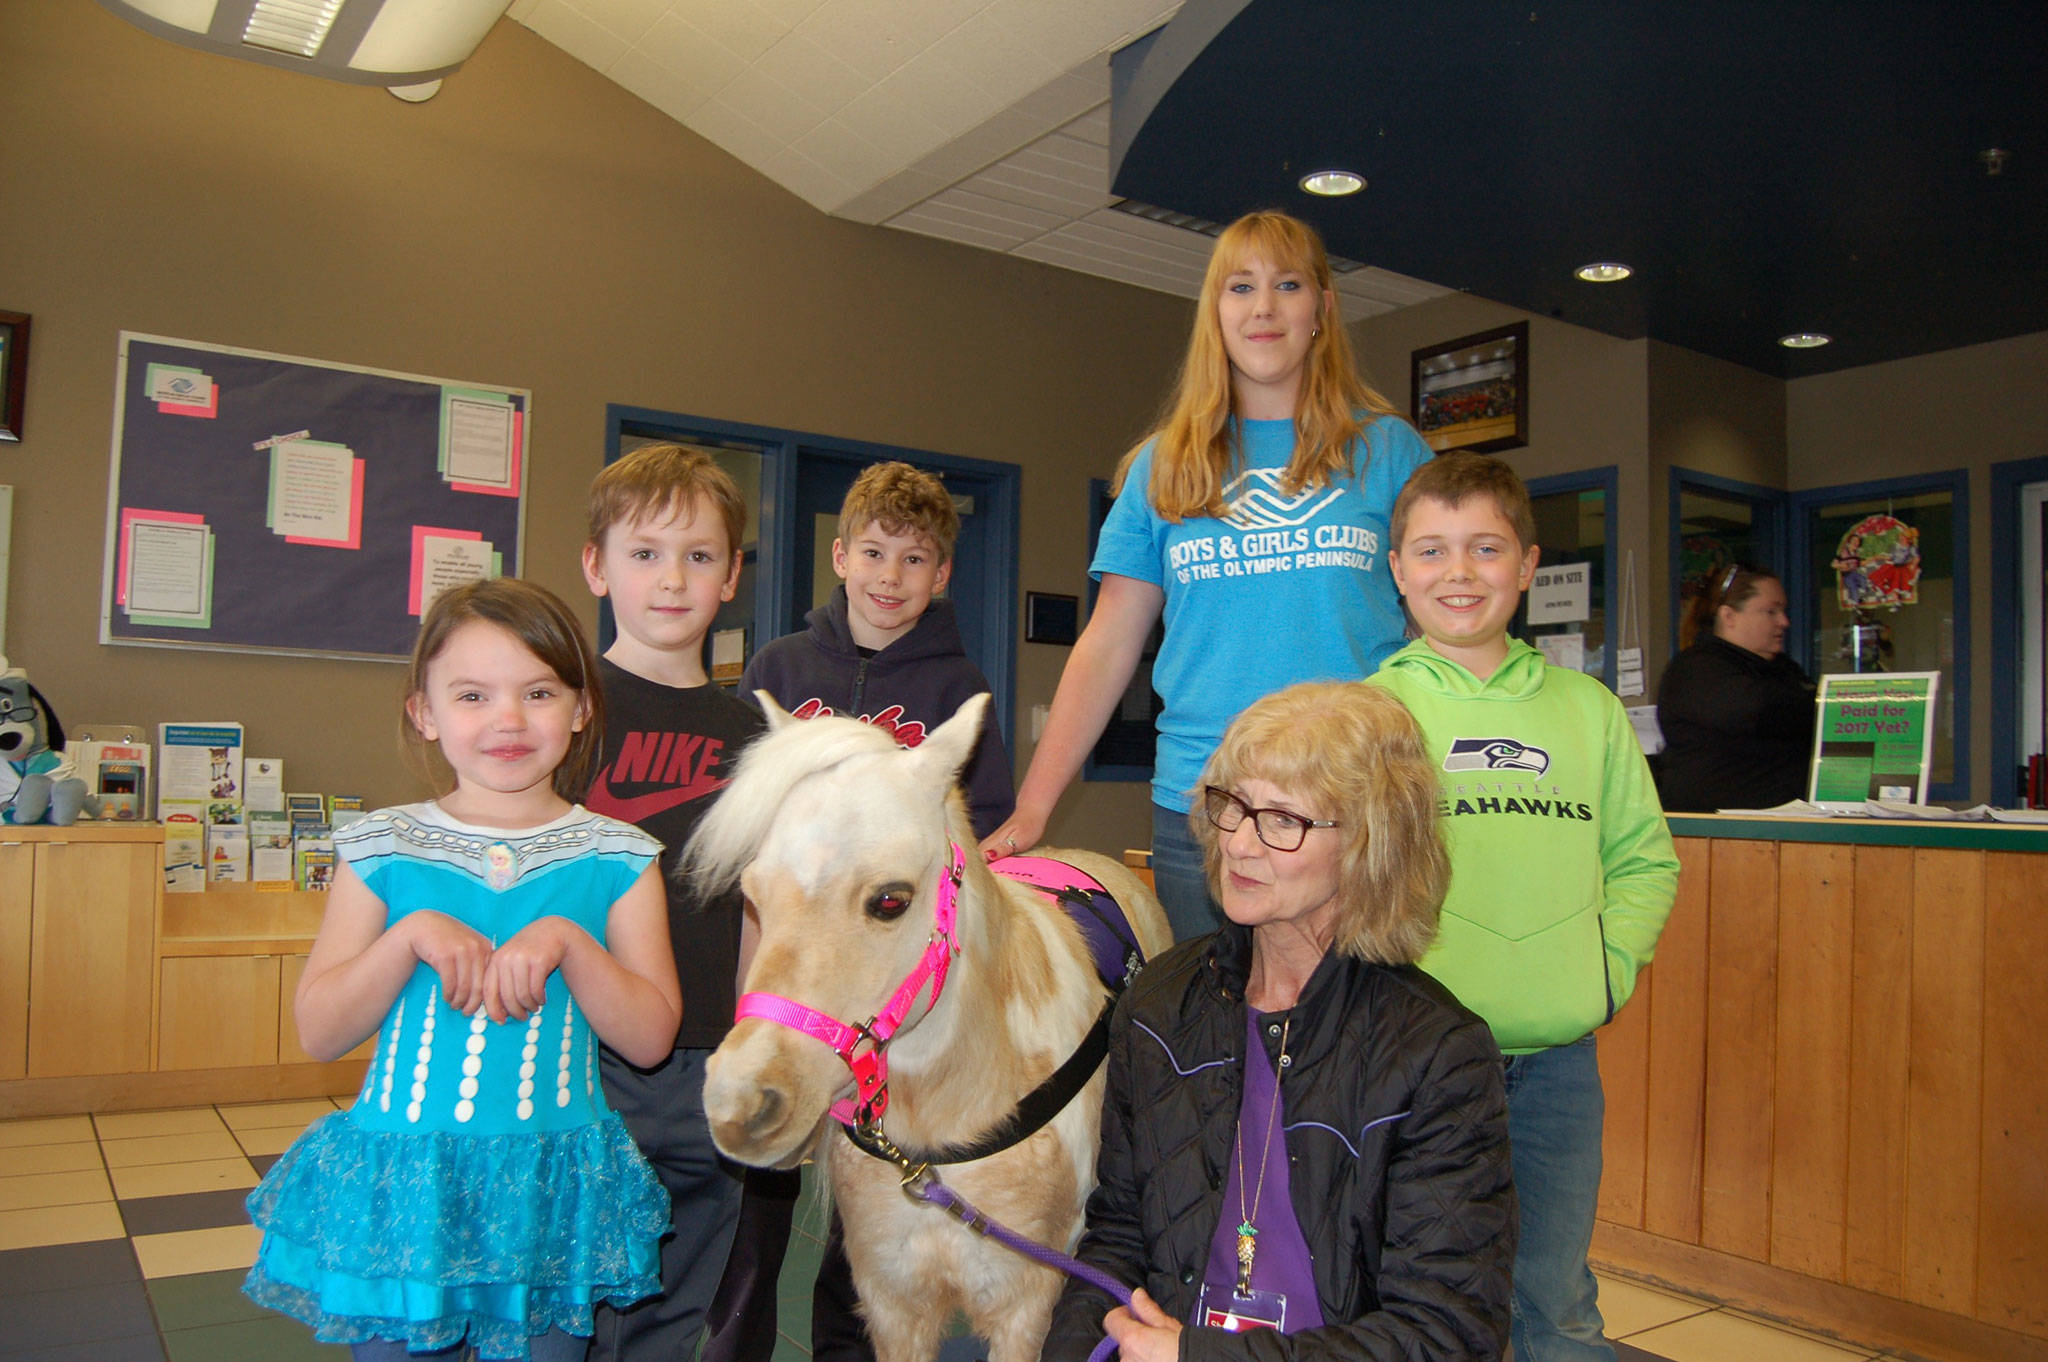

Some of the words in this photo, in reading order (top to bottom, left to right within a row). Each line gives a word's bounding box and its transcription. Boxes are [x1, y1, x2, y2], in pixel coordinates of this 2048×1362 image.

[1169, 536, 1216, 570] BOYS
[1219, 535, 1239, 561] &
[1241, 527, 1309, 557] GIRLS
[1314, 524, 1379, 555] CLUBS
[1177, 569, 1191, 584] OF
[1192, 562, 1221, 581] THE
[1223, 556, 1292, 577] OLYMPIC
[1295, 550, 1374, 573] PENINSULA
[1566, 571, 1582, 584] SITE
[1841, 704, 1878, 717] Paid
[1884, 703, 1907, 717] for
[1835, 721, 1870, 734] 2017
[1874, 720, 1910, 734] Yet?
[610, 731, 725, 786] NIKE
[1437, 797, 1593, 821] EAHAWKS
